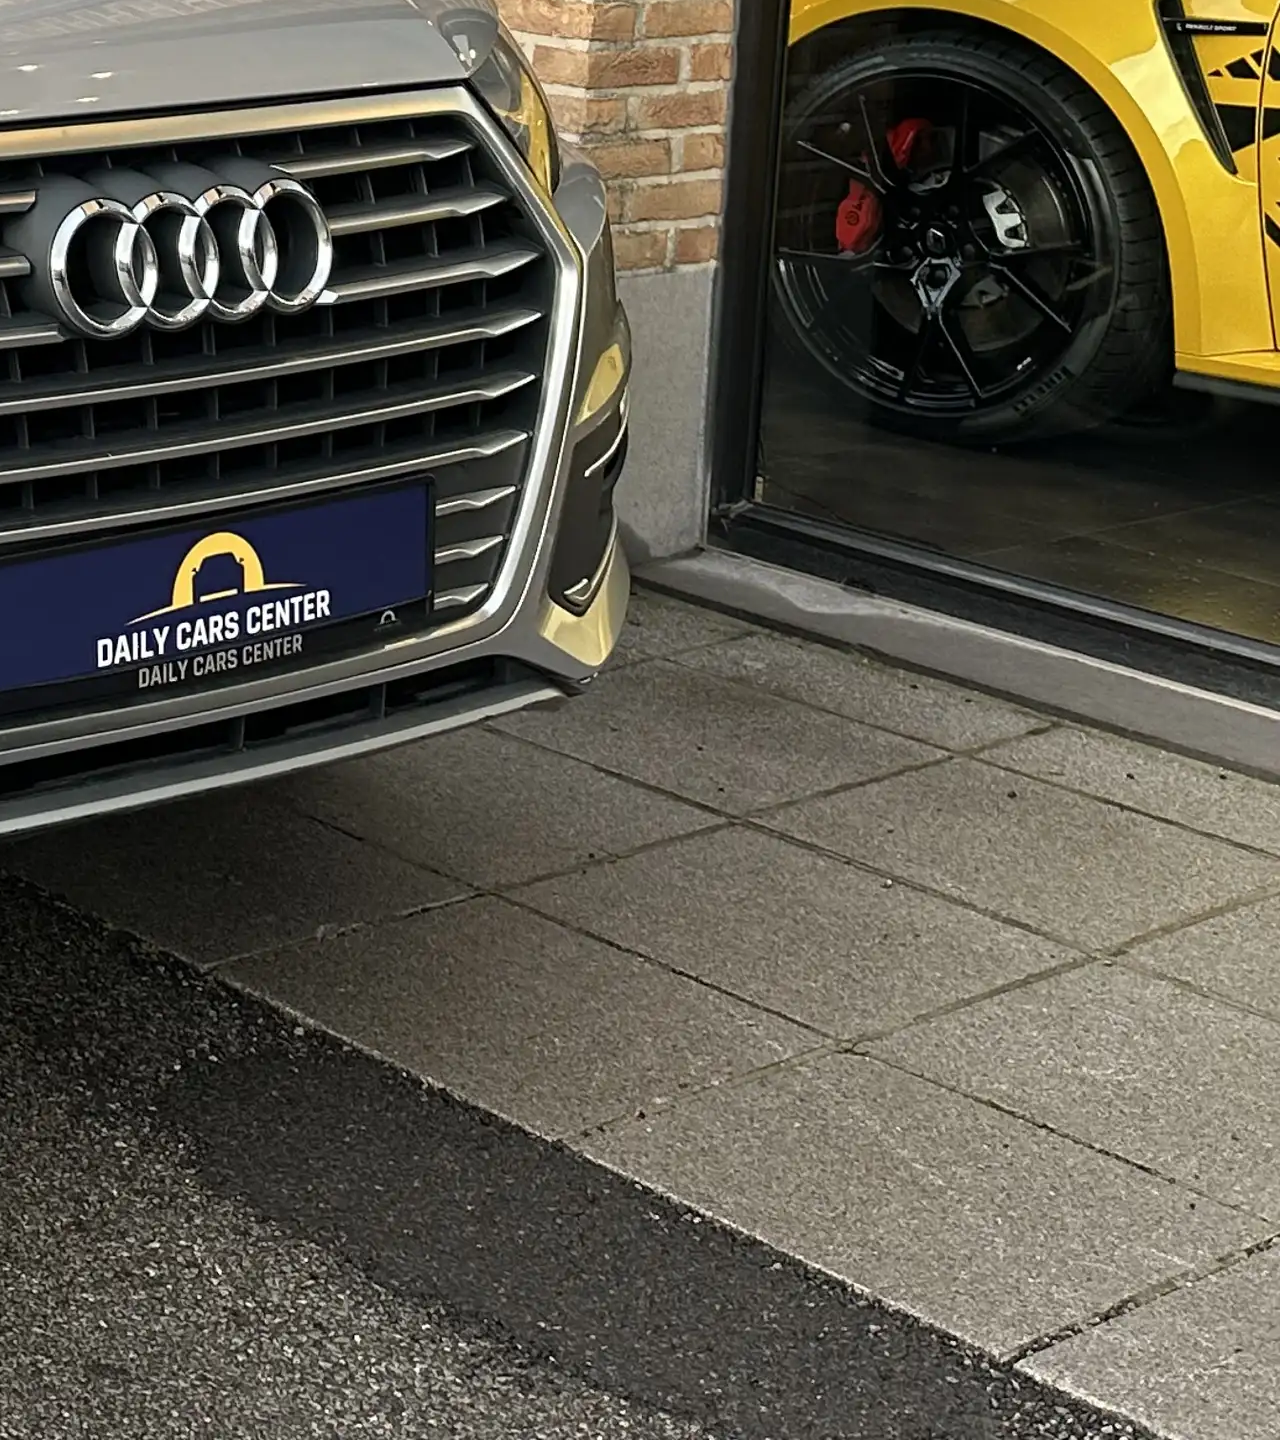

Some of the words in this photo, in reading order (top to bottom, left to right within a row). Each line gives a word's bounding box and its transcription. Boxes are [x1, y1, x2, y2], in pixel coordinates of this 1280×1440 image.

[97, 626, 169, 667] DAILY
[176, 611, 240, 651] CARS
[246, 589, 331, 633] CENTER
[138, 659, 189, 688] DAILY
[194, 649, 238, 676] CARS
[244, 634, 302, 665] CENTER
